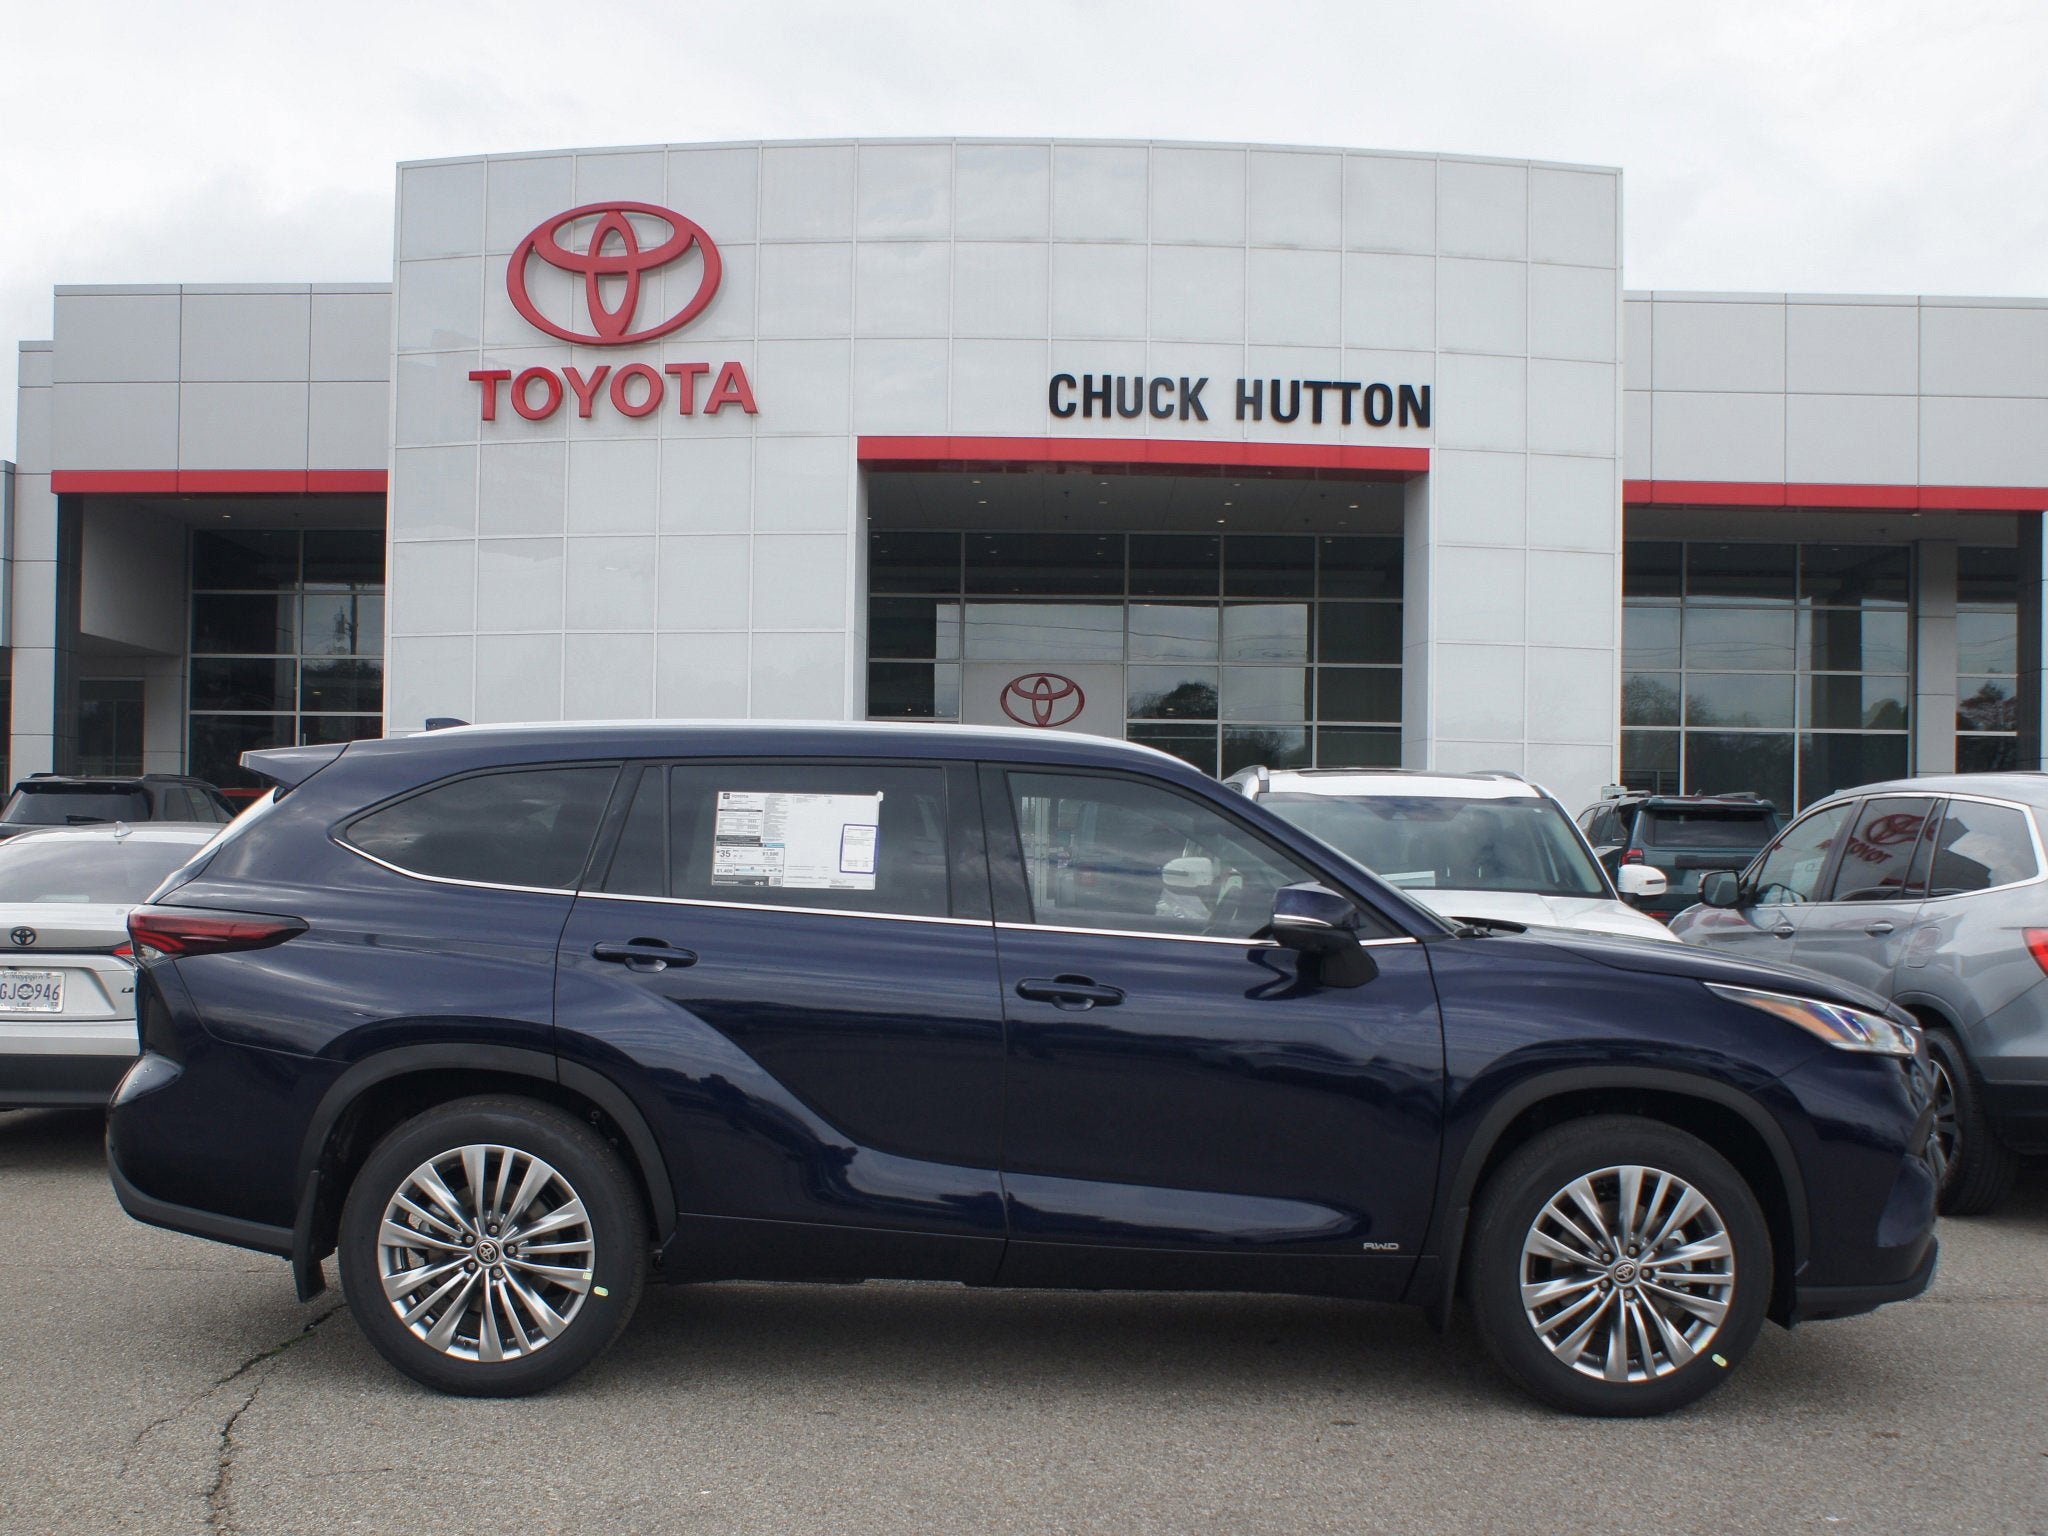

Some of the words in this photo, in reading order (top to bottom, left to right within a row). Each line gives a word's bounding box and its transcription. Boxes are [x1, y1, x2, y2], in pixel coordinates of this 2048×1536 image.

[469, 361, 759, 421] TOYOTA
[1048, 373, 1209, 421] CHUCK
[1235, 378, 1431, 428] HUTTON
[720, 849, 732, 858] 35
[34, 983, 61, 1001] 946
[1363, 1242, 1399, 1250] AWD
